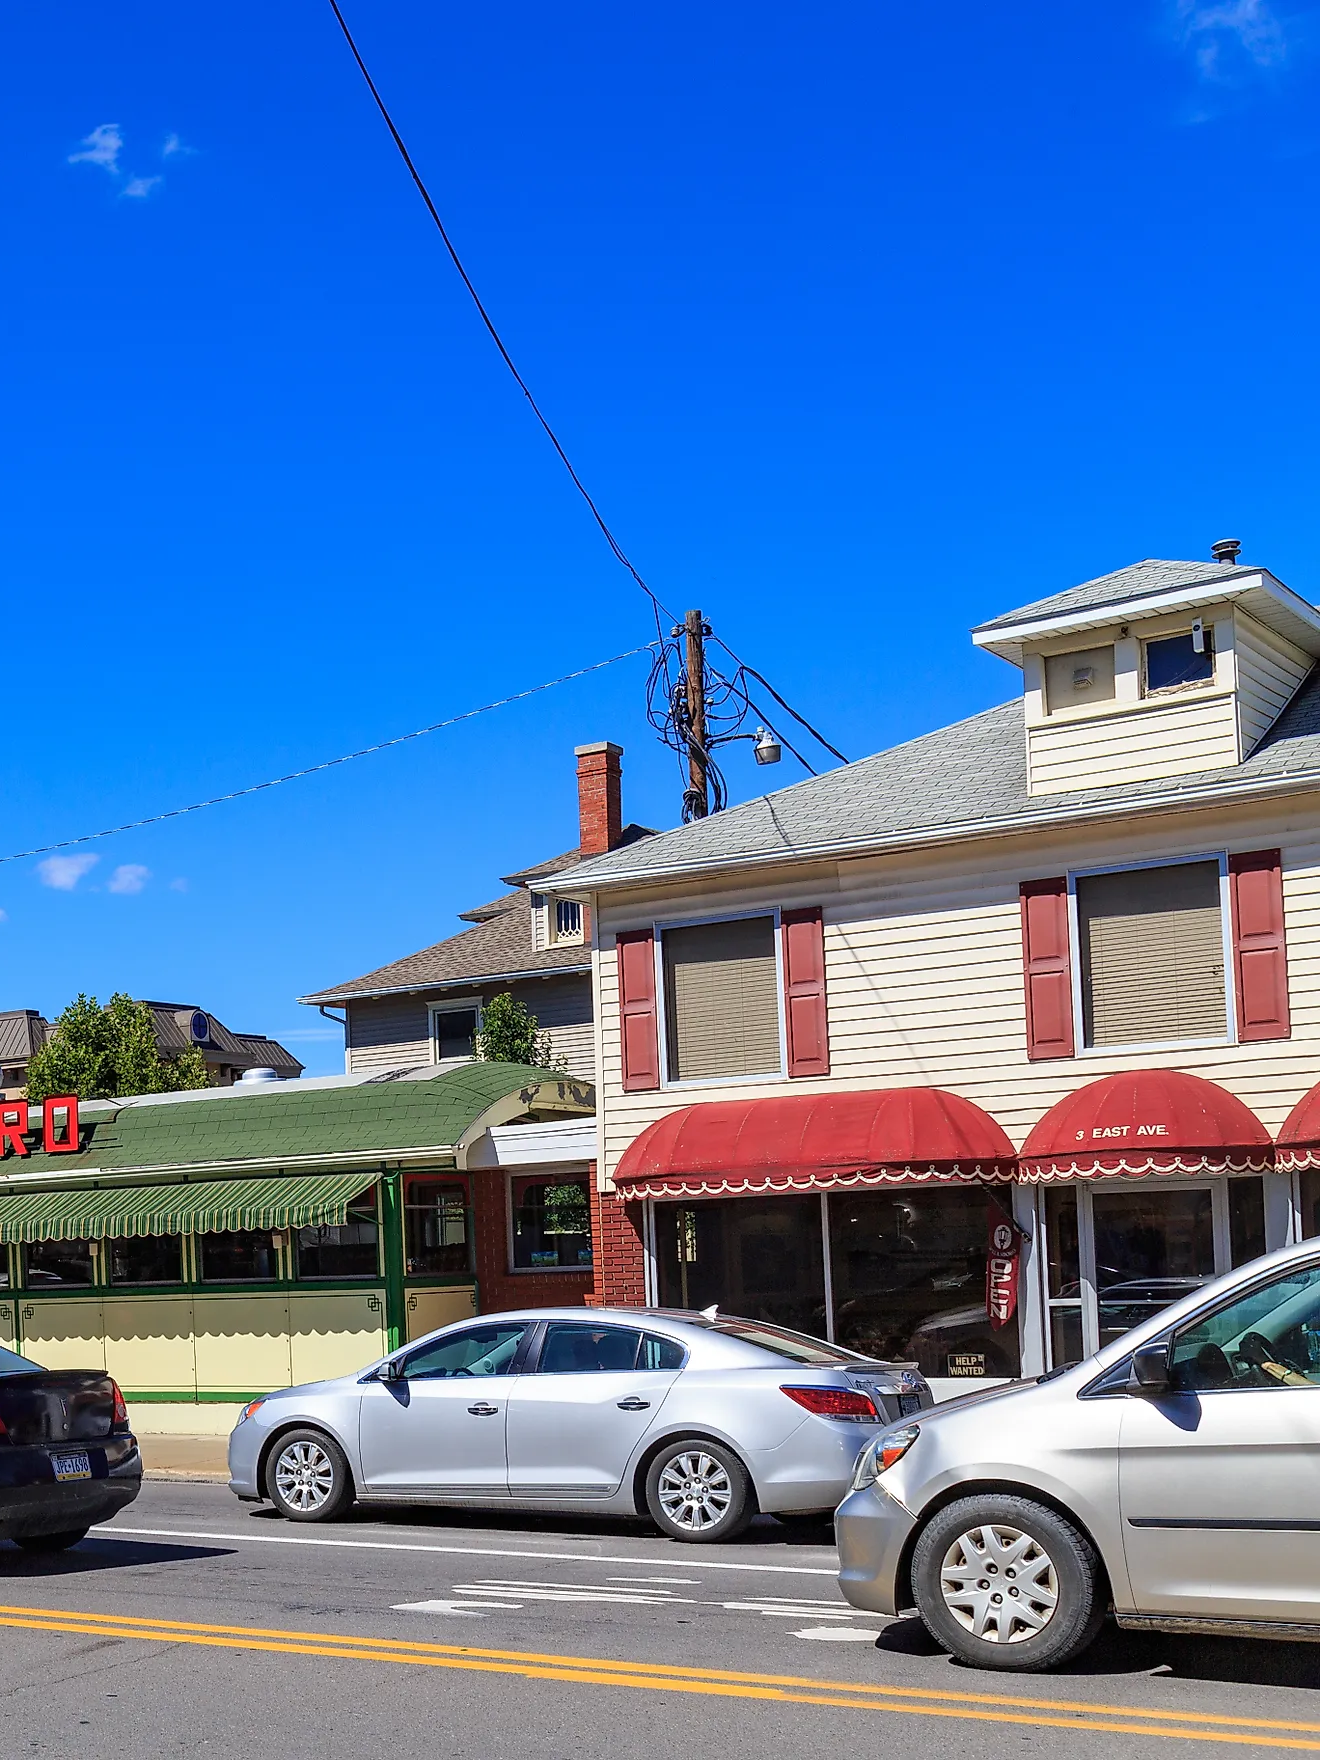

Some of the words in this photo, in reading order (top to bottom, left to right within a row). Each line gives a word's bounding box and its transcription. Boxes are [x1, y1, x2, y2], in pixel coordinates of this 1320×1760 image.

[1075, 1130, 1085, 1141] 3
[1092, 1125, 1130, 1139] EAST
[1136, 1124, 1169, 1136] AVE.
[989, 1258, 1013, 1320] OPEN
[955, 1356, 977, 1366] HELP
[950, 1366, 984, 1376] WANTED
